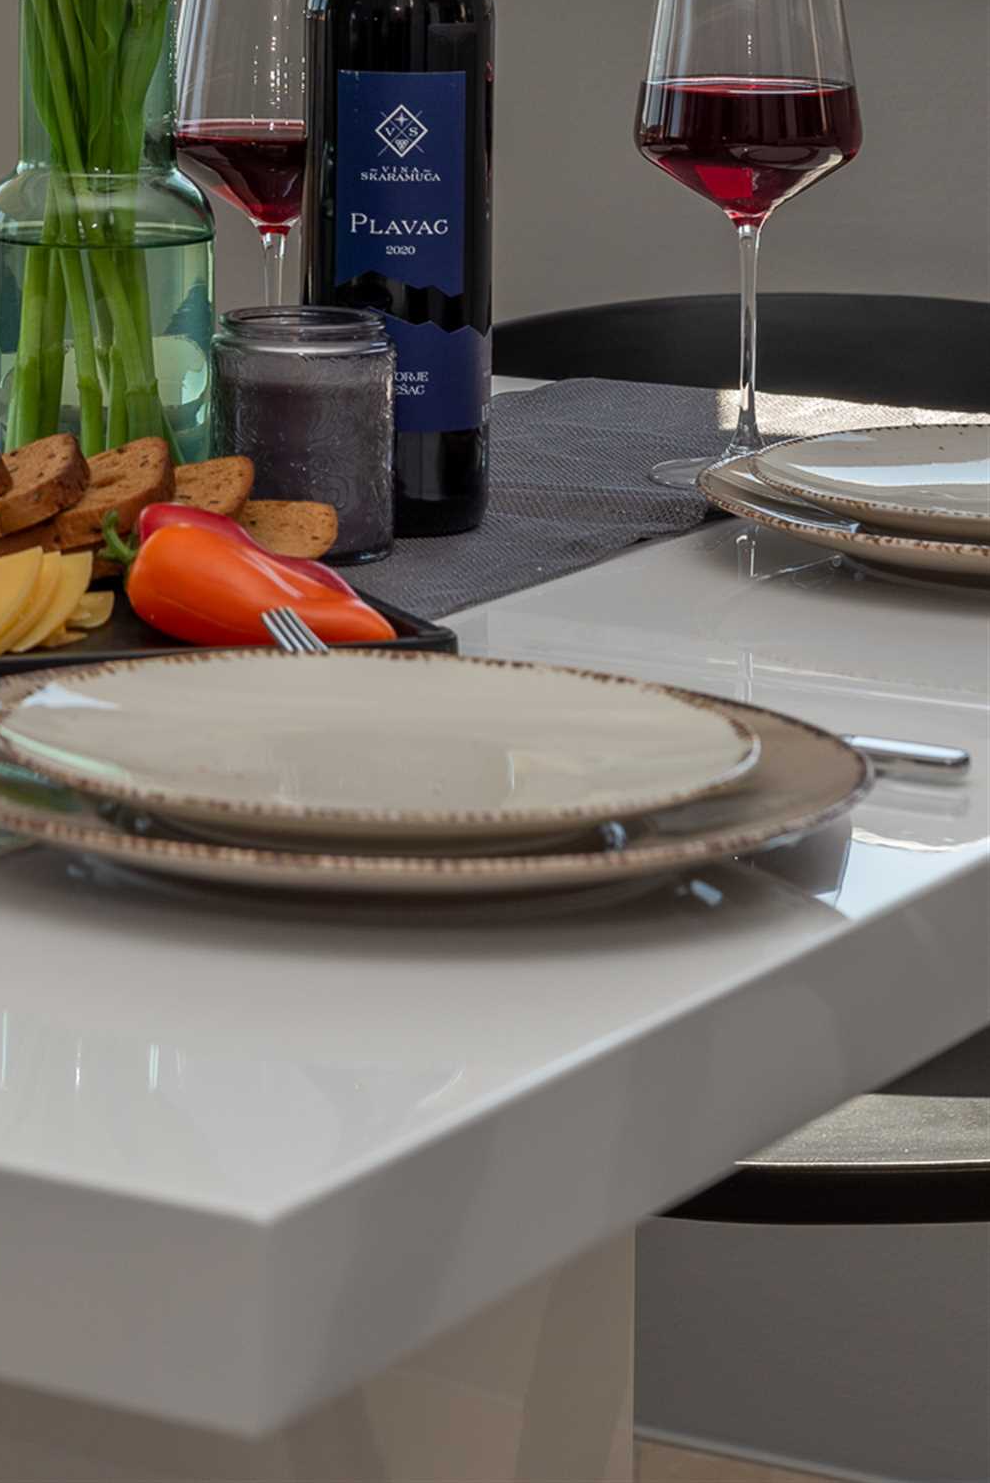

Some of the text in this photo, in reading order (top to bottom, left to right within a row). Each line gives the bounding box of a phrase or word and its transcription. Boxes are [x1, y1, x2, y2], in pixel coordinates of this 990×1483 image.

[409, 126, 419, 137] S
[385, 245, 416, 255] 2020
[393, 371, 429, 382] ORJE
